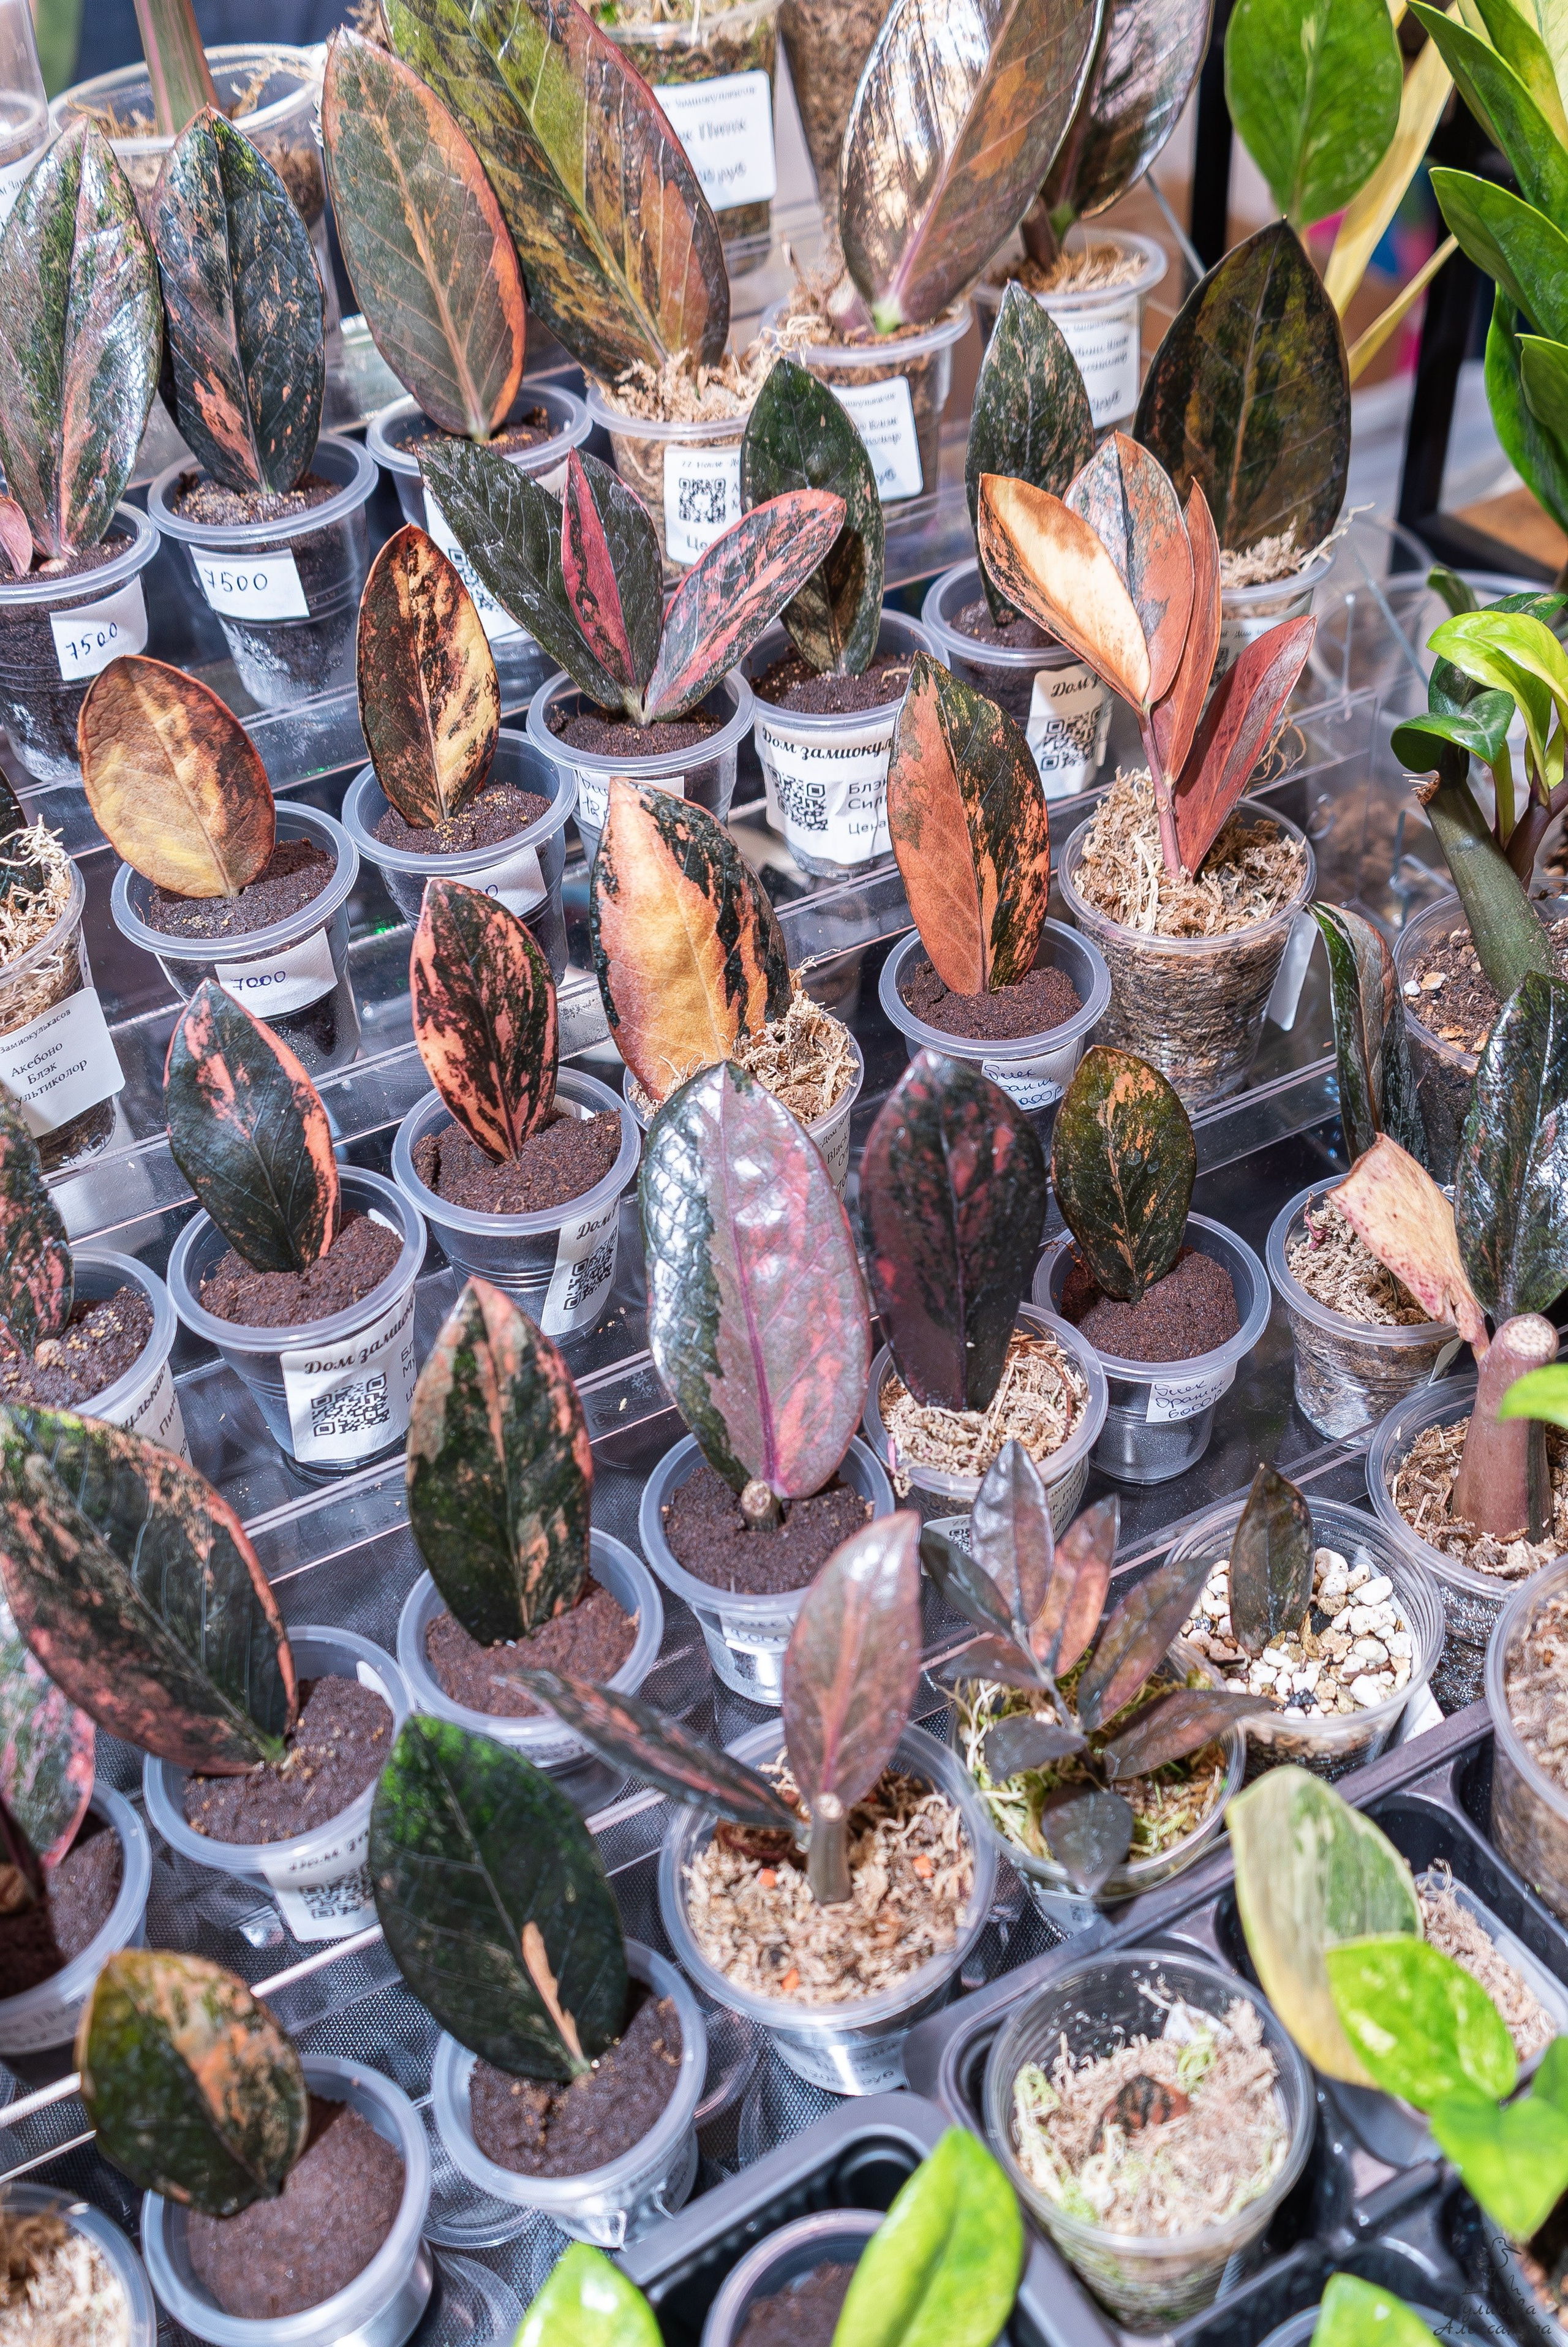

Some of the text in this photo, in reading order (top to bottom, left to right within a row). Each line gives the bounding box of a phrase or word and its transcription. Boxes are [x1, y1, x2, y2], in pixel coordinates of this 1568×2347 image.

[204, 568, 268, 592] 7500
[65, 622, 117, 660] 7500
[1050, 677, 1088, 698] Дом
[230, 971, 286, 990] 7000
[0, 1009, 71, 1054] Замиокулькасов
[11, 1042, 63, 1078] Акебоно
[27, 1061, 58, 1085] Блэк
[576, 1213, 611, 1240] Дом
[304, 1354, 355, 1374] Дом
